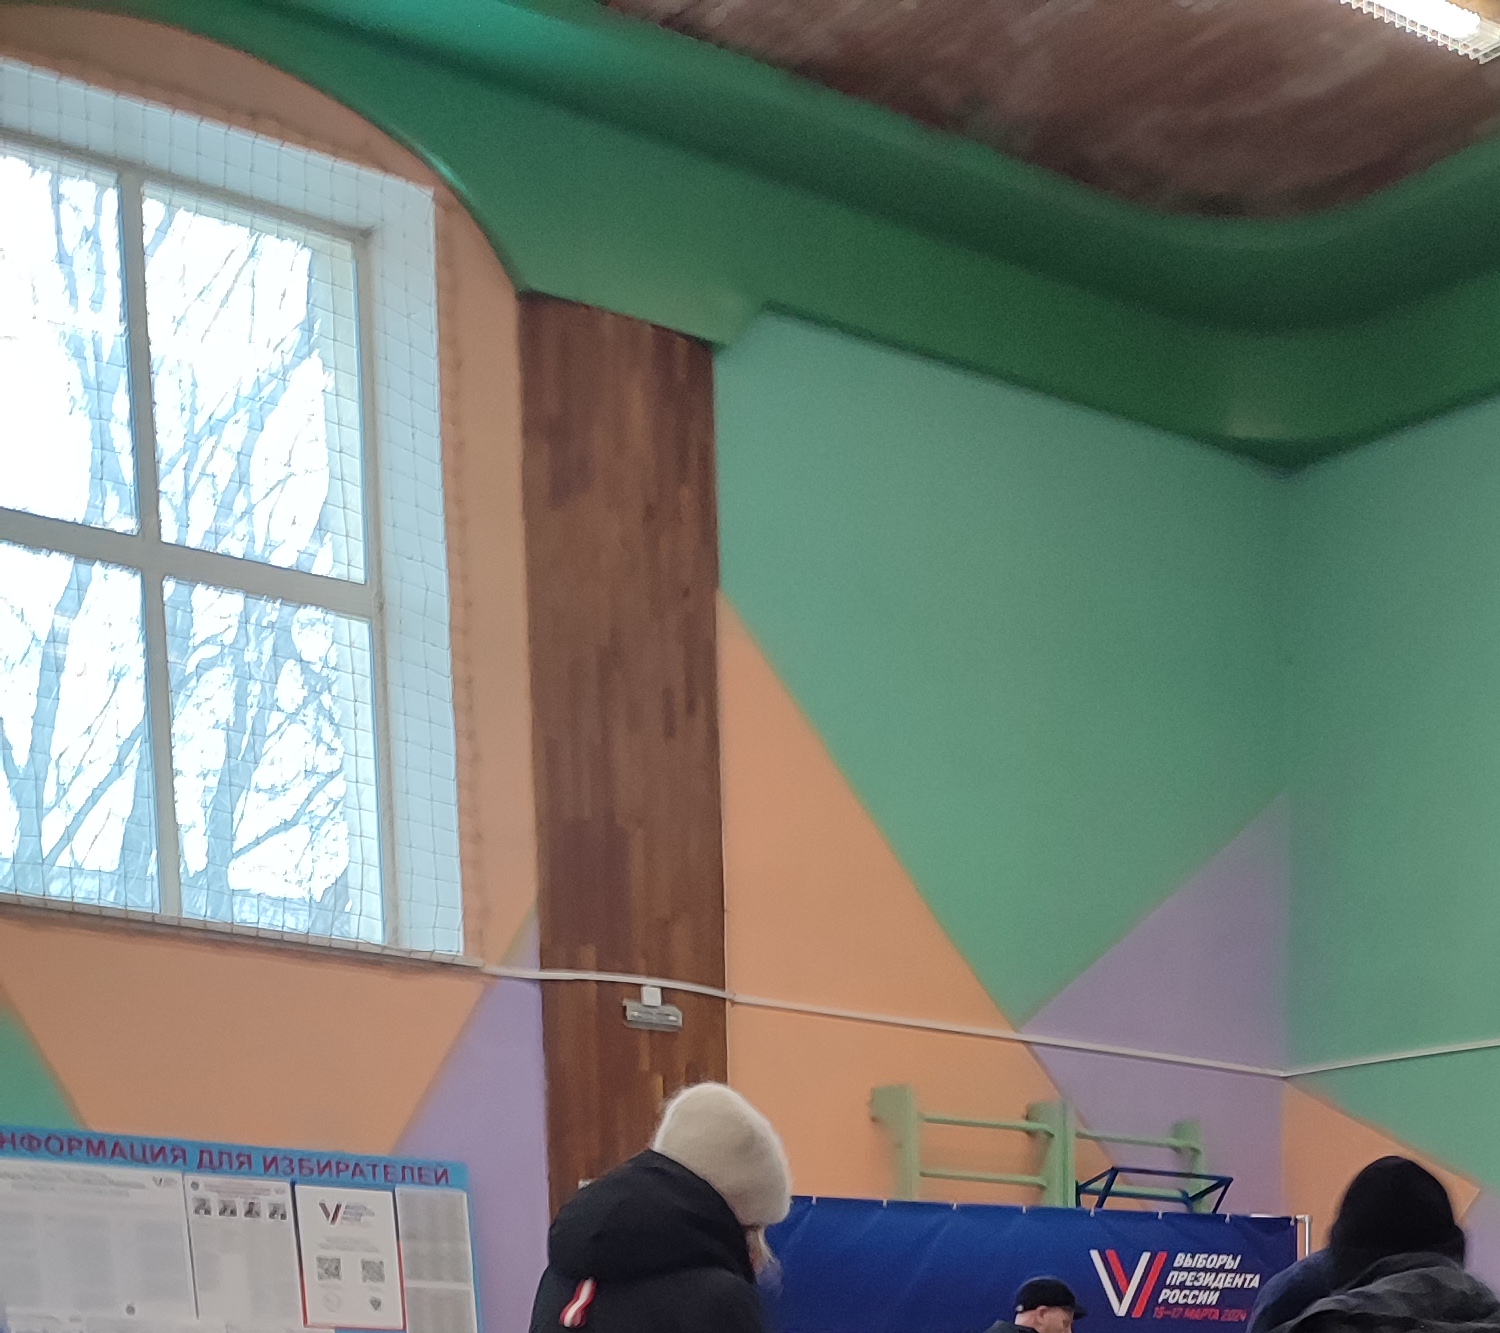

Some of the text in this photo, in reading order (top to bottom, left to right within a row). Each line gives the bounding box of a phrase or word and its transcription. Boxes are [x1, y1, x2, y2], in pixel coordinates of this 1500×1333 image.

[197, 1149, 253, 1172] ДЛЯ
[261, 1154, 450, 1185] ИЗБИРАТЕЛЕЙ
[1172, 1252, 1242, 1270] ВЫБОРЫ
[1165, 1270, 1260, 1290] ПРЕЗИДЕНТА
[1158, 1288, 1220, 1306] РОССИИ
[1184, 1307, 1220, 1321] МАРТА
[1220, 1308, 1247, 1322] 2024
